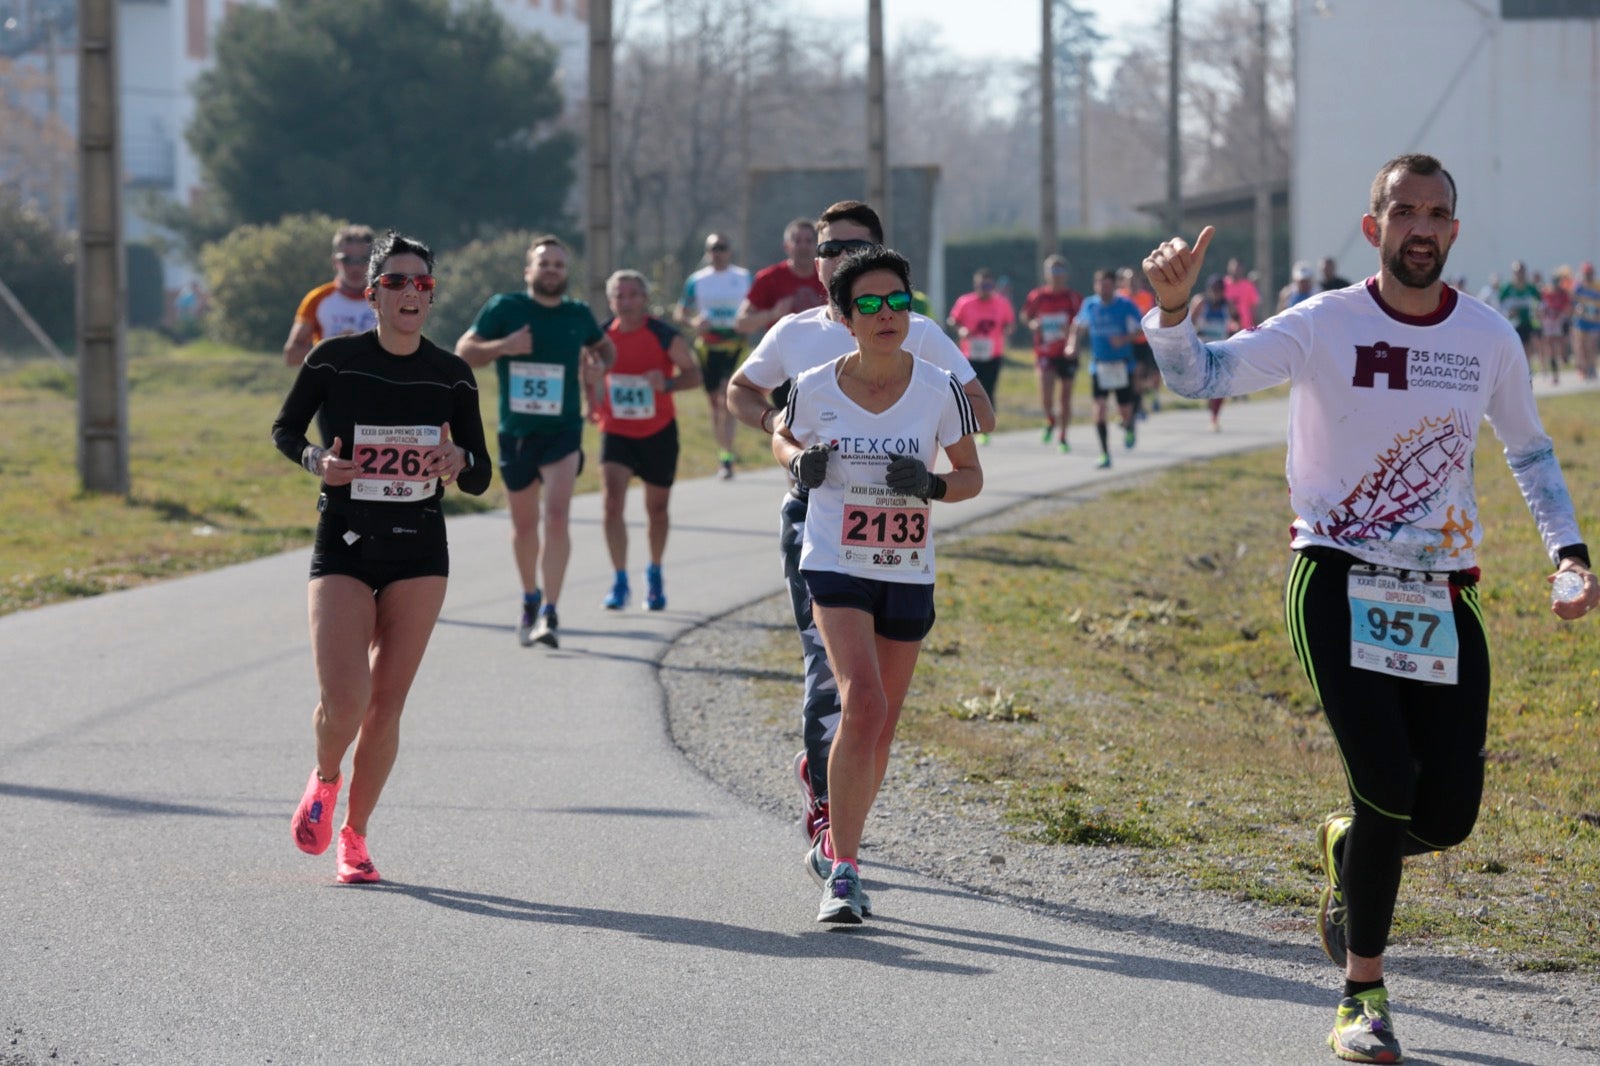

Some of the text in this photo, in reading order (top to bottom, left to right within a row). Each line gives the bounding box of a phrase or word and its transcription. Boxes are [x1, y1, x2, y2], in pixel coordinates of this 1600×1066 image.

[1411, 350, 1480, 367] 35 MEDIA
[1410, 365, 1480, 381] MARATÓN
[523, 379, 547, 398] 55
[1410, 378, 1479, 392] CÓRDOBA 2019
[378, 428, 394, 436] GRAN
[394, 428, 415, 436] PREMIO
[841, 437, 919, 454] TEXCON
[869, 487, 885, 496] GRAN
[846, 510, 926, 543] 2133
[1377, 579, 1396, 589] GRAN
[1367, 606, 1441, 648] 957
